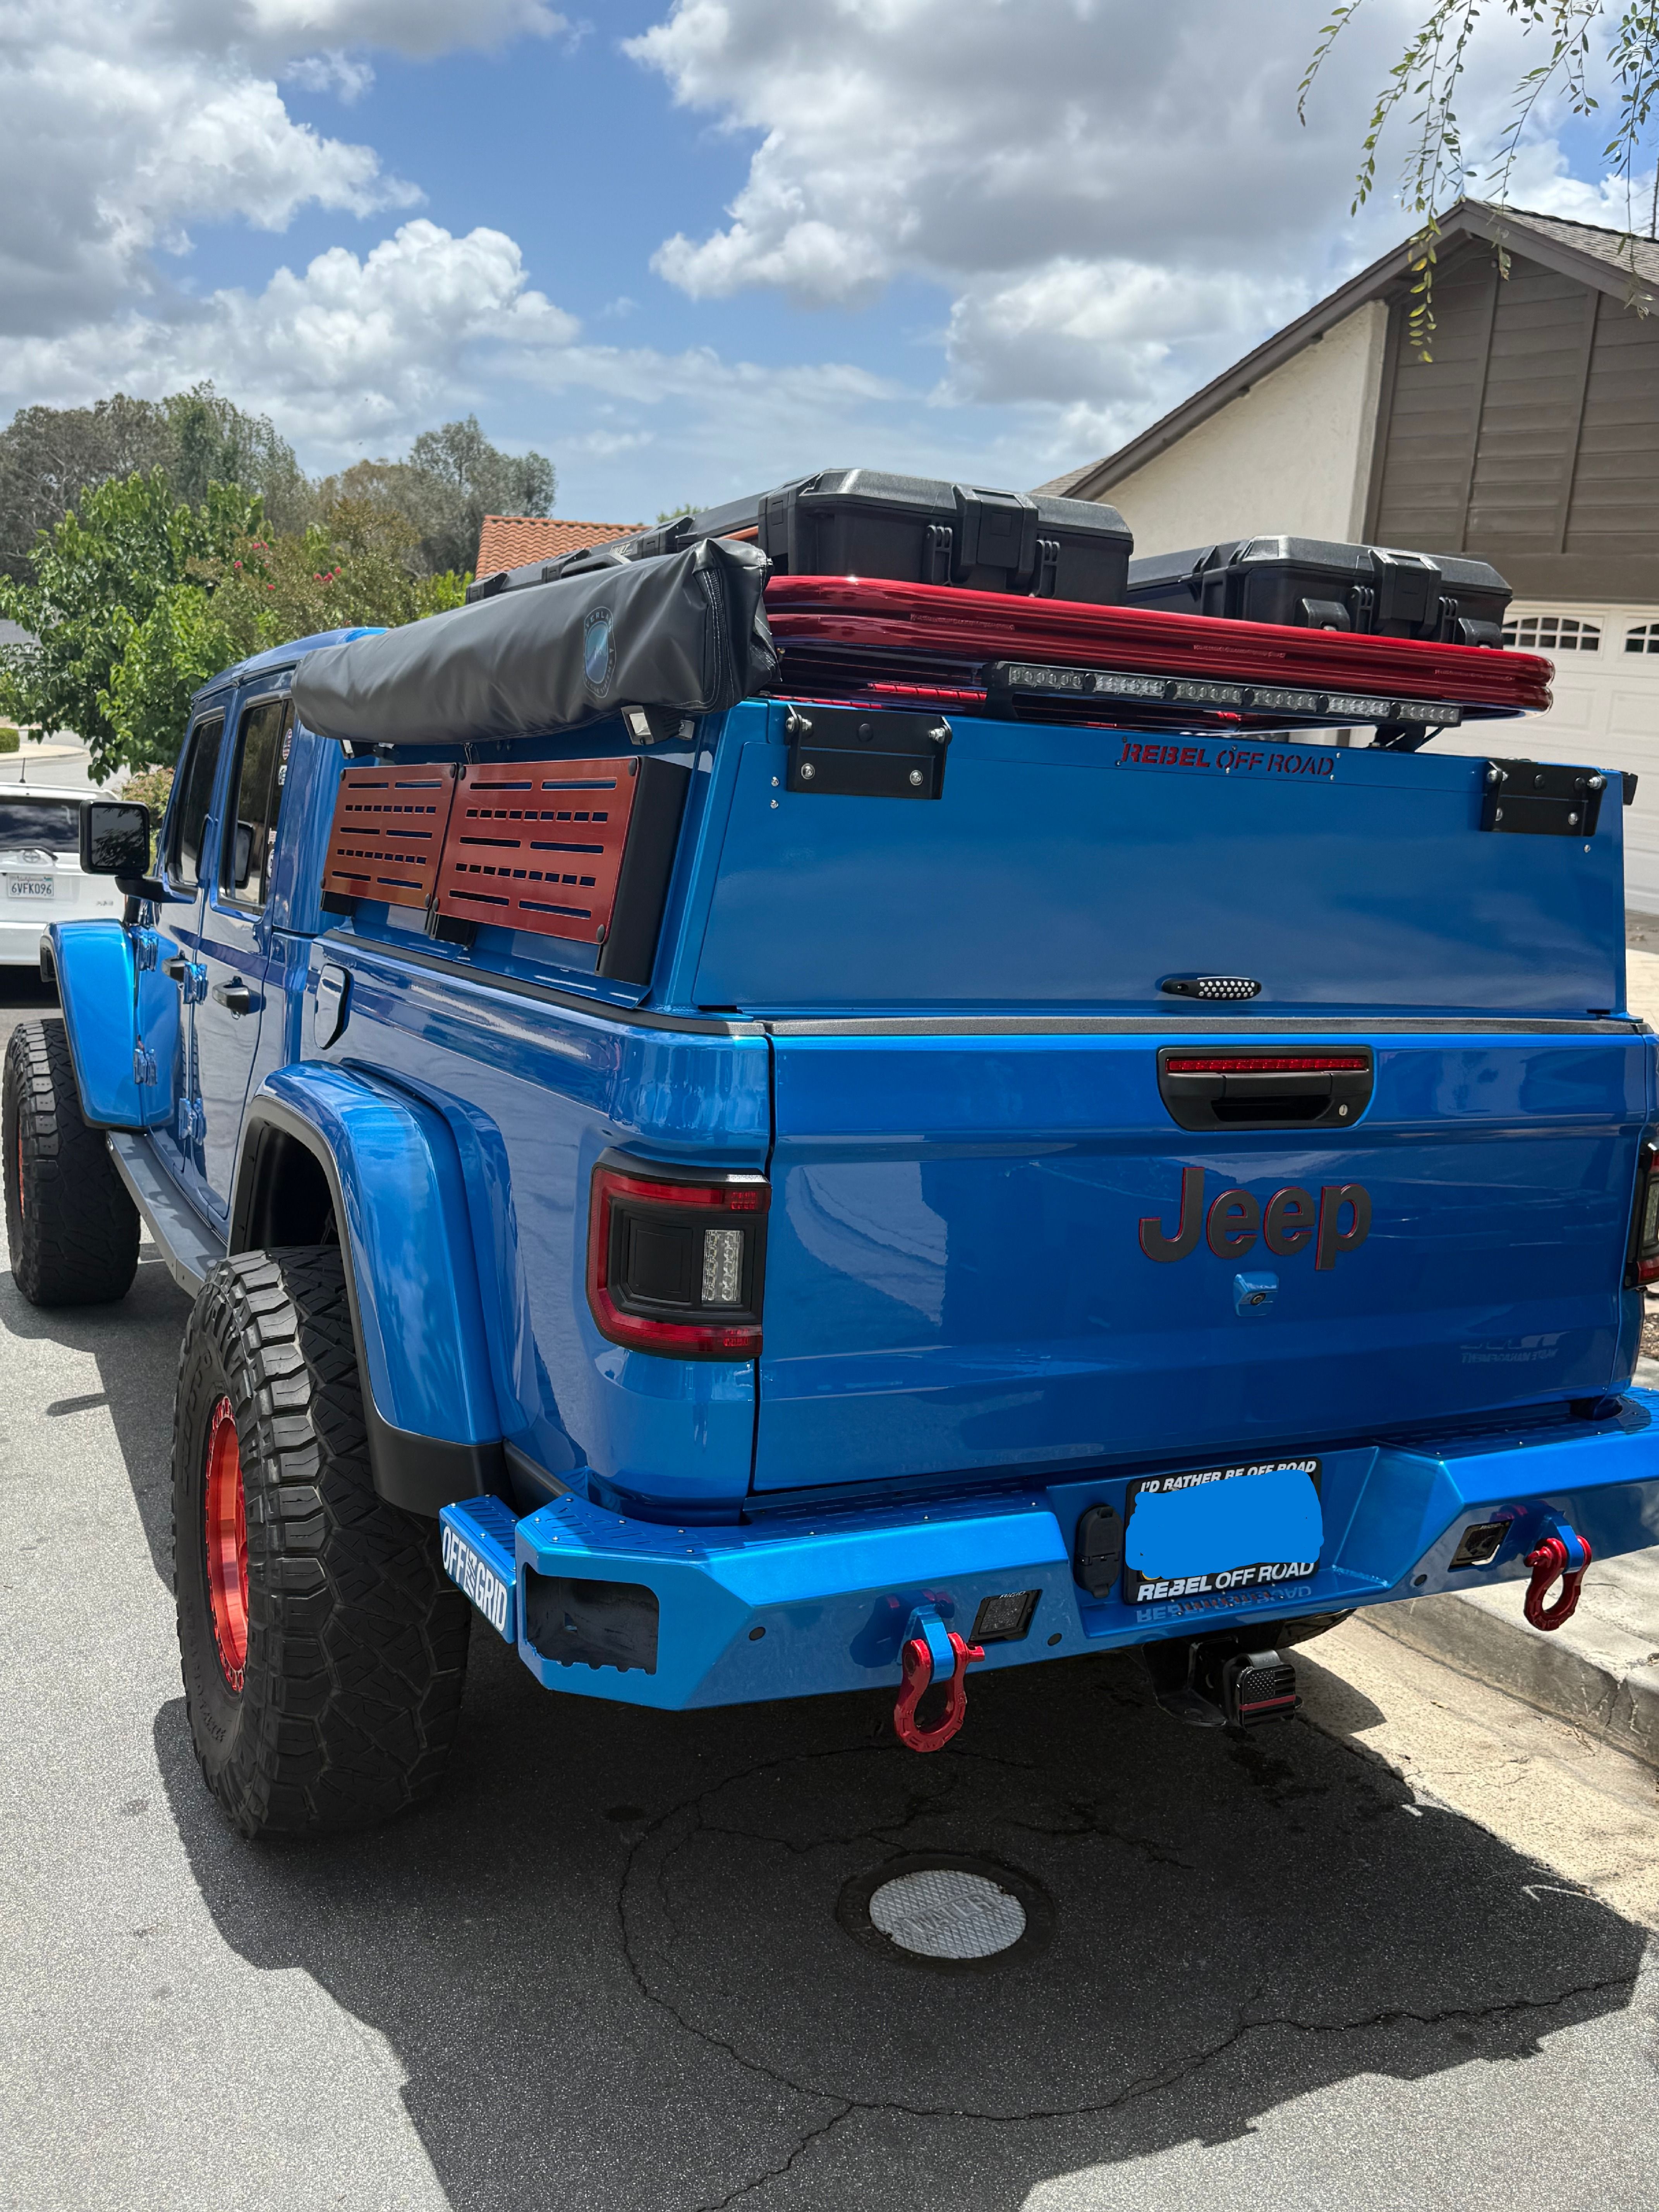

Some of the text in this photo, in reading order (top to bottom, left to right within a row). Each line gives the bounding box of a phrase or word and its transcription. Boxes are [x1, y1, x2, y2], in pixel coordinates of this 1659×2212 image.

[1121, 743, 1334, 776] REBEL OFF ROAD
[11, 883, 52, 895] 6VFK096
[1139, 1166, 1372, 1270] Jeep
[1140, 1480, 1159, 1493] I'D
[1163, 1472, 1221, 1491] RATHER
[442, 1526, 507, 1632] OFF GRID
[1137, 1576, 1212, 1602] REBEL
[1216, 1566, 1256, 1589] OFF
[1257, 1563, 1314, 1583] ROAD
